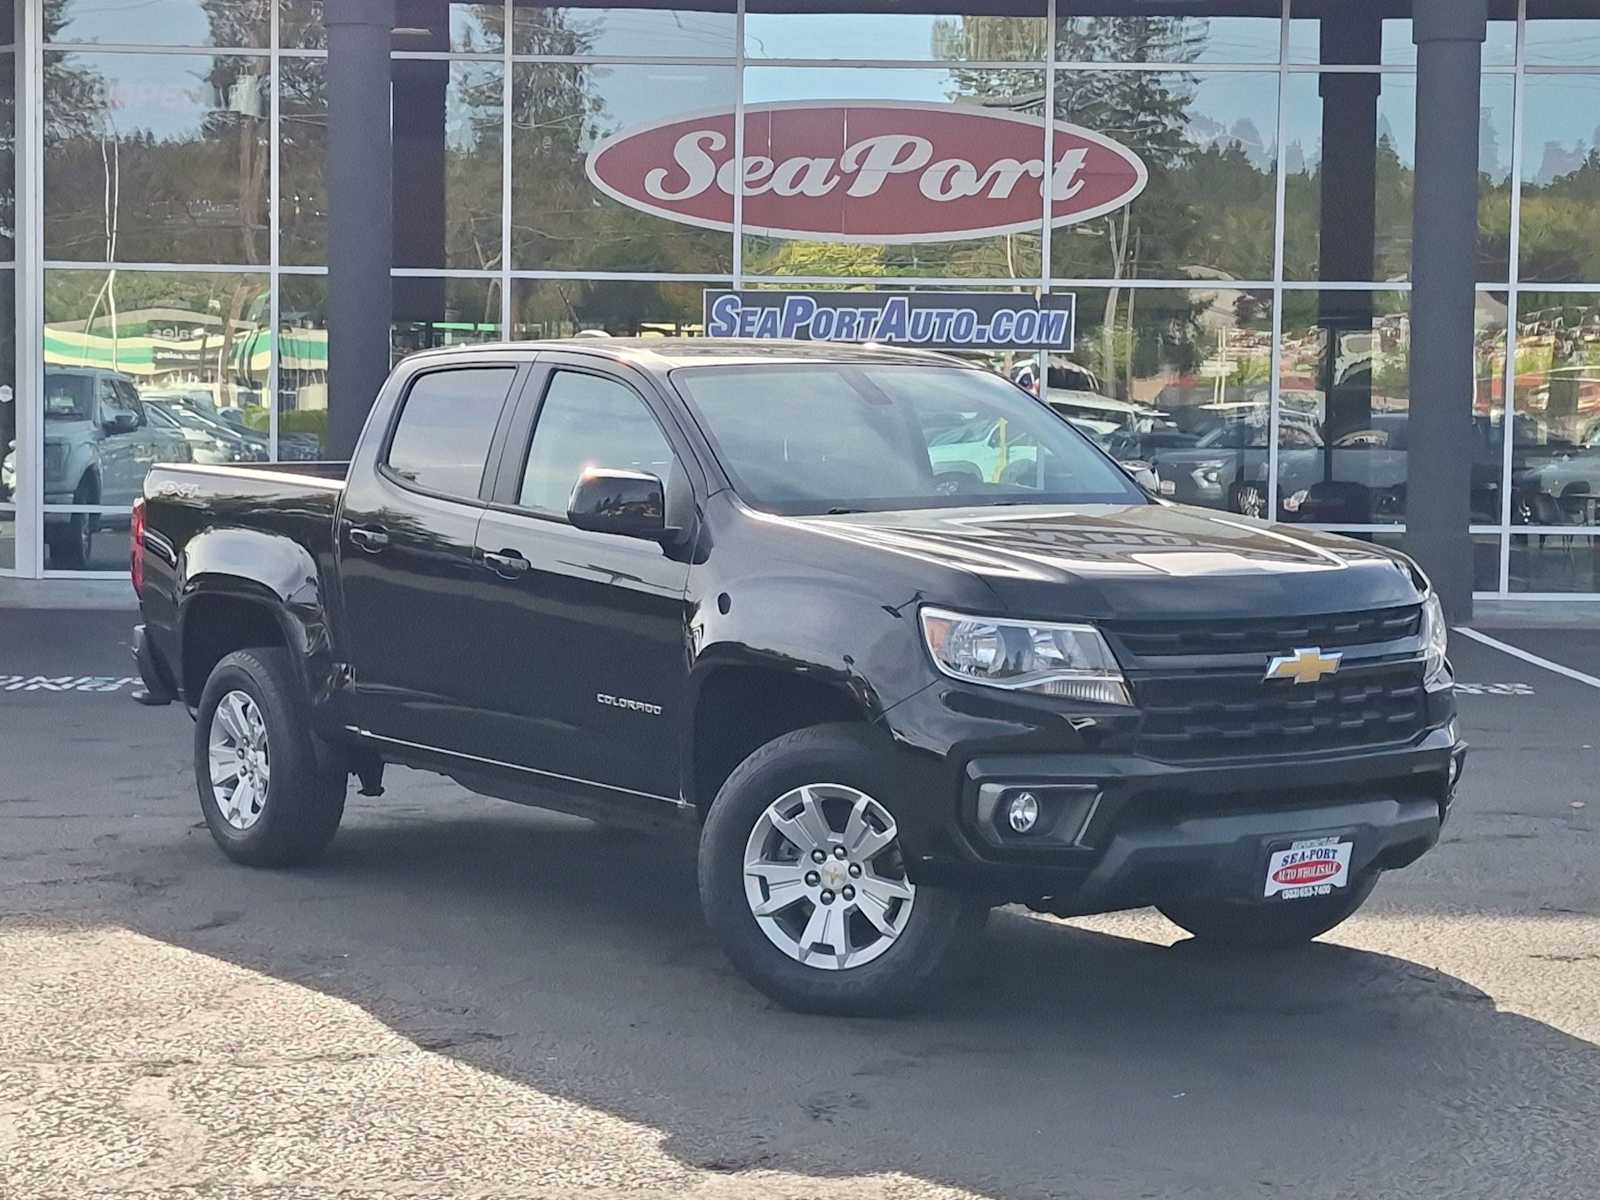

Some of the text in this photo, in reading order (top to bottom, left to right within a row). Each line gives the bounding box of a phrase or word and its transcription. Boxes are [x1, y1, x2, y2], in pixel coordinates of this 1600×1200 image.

[644, 129, 1089, 202] SeaPort
[596, 693, 663, 715] COLORADO
[1278, 868, 1297, 881] AUTO
